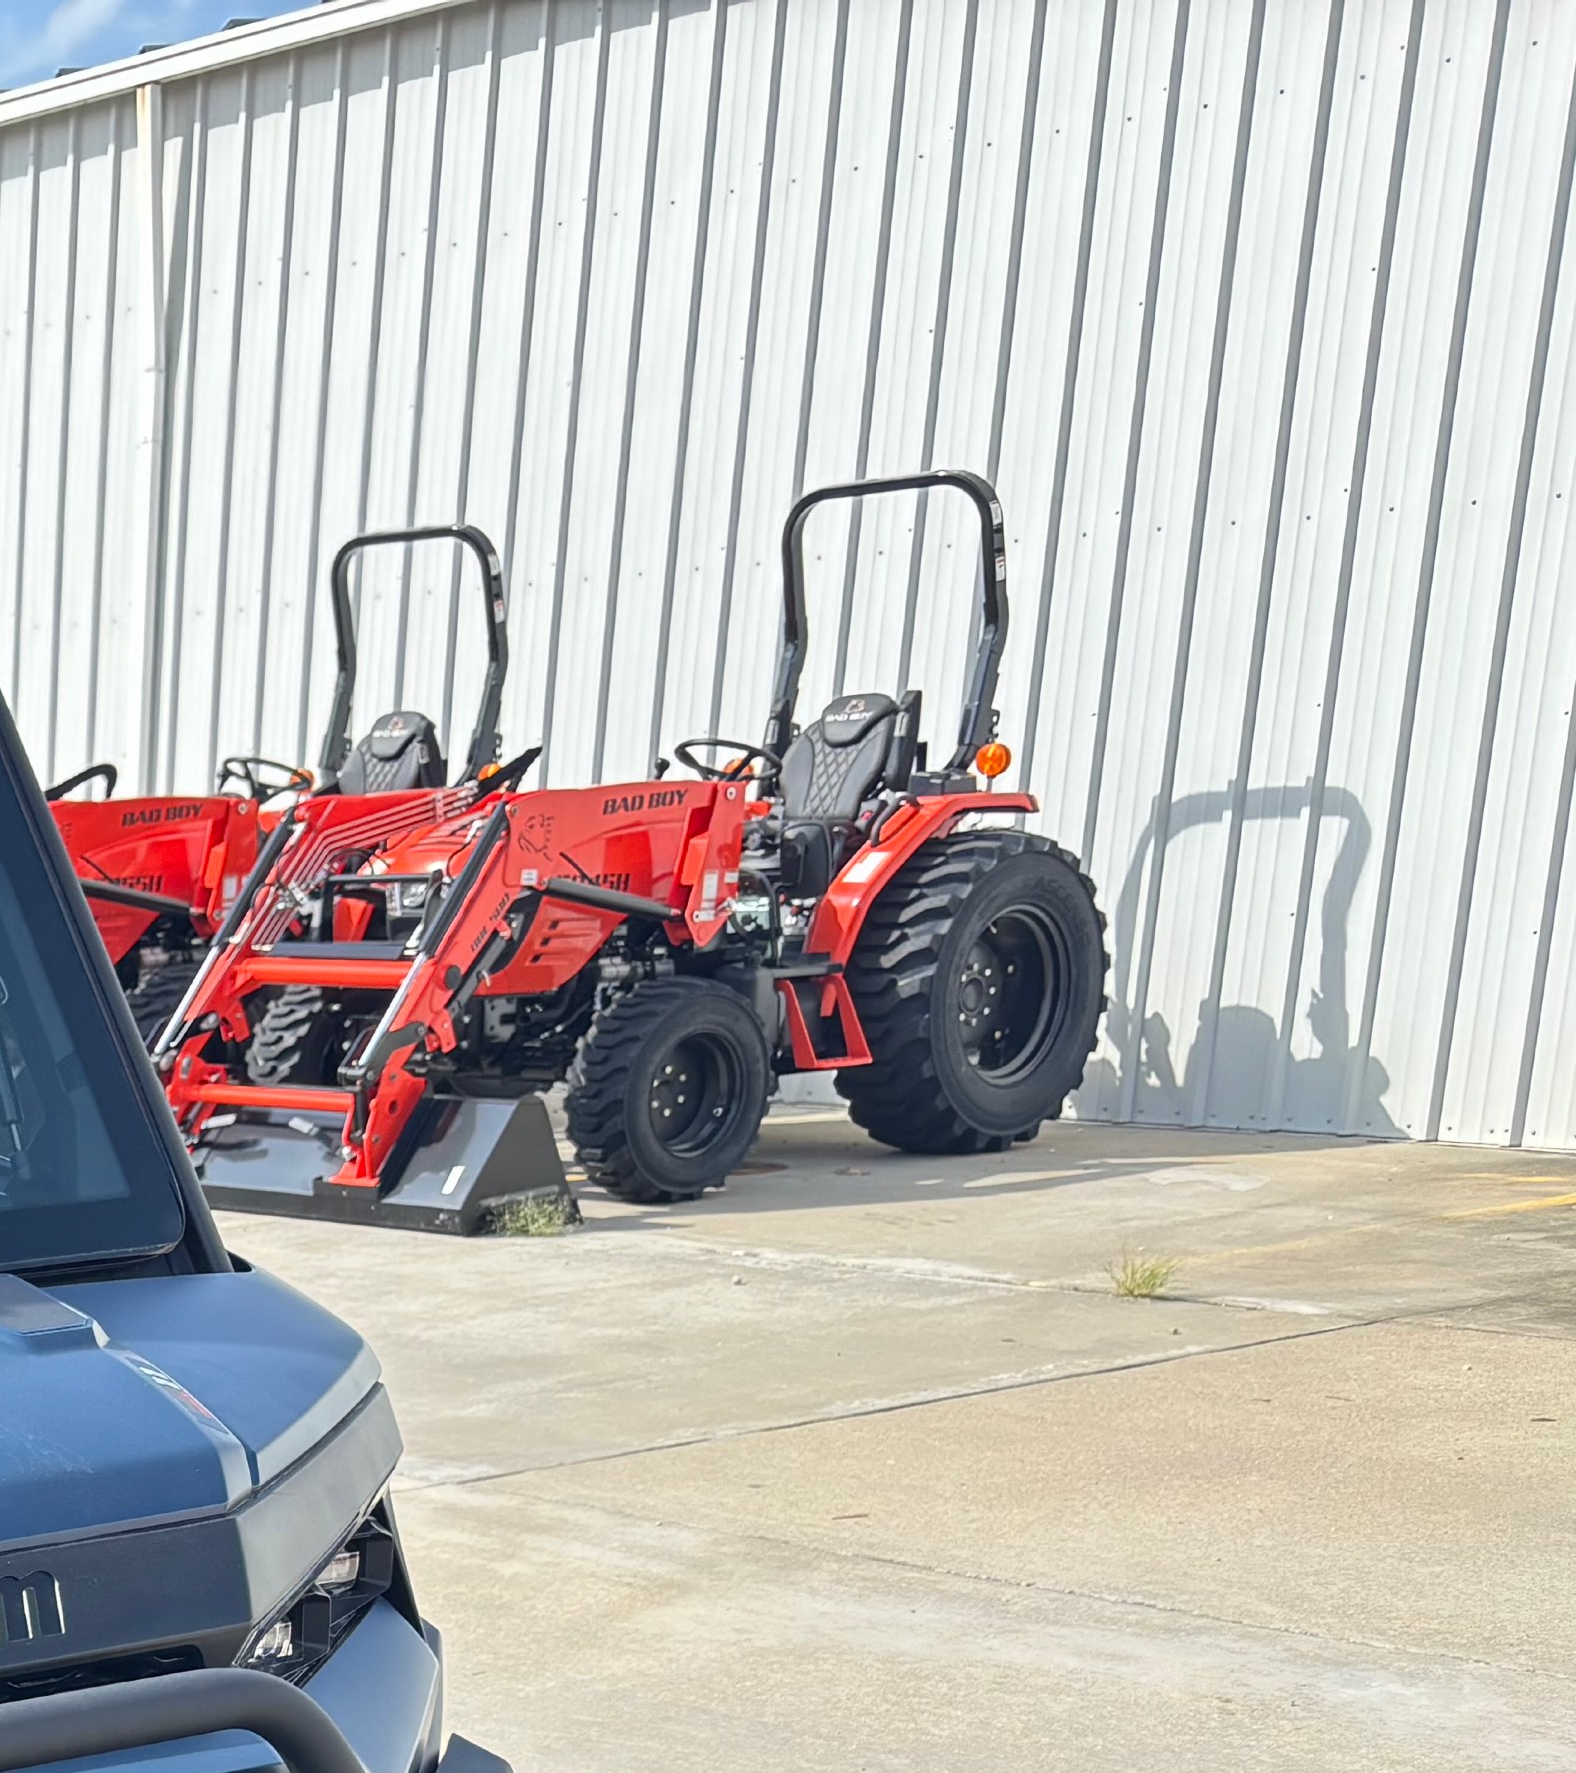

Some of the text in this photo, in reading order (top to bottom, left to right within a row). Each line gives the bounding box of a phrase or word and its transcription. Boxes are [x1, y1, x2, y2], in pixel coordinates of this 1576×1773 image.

[602, 788, 689, 815] BAD BOY
[121, 803, 203, 827] BAD BOY
